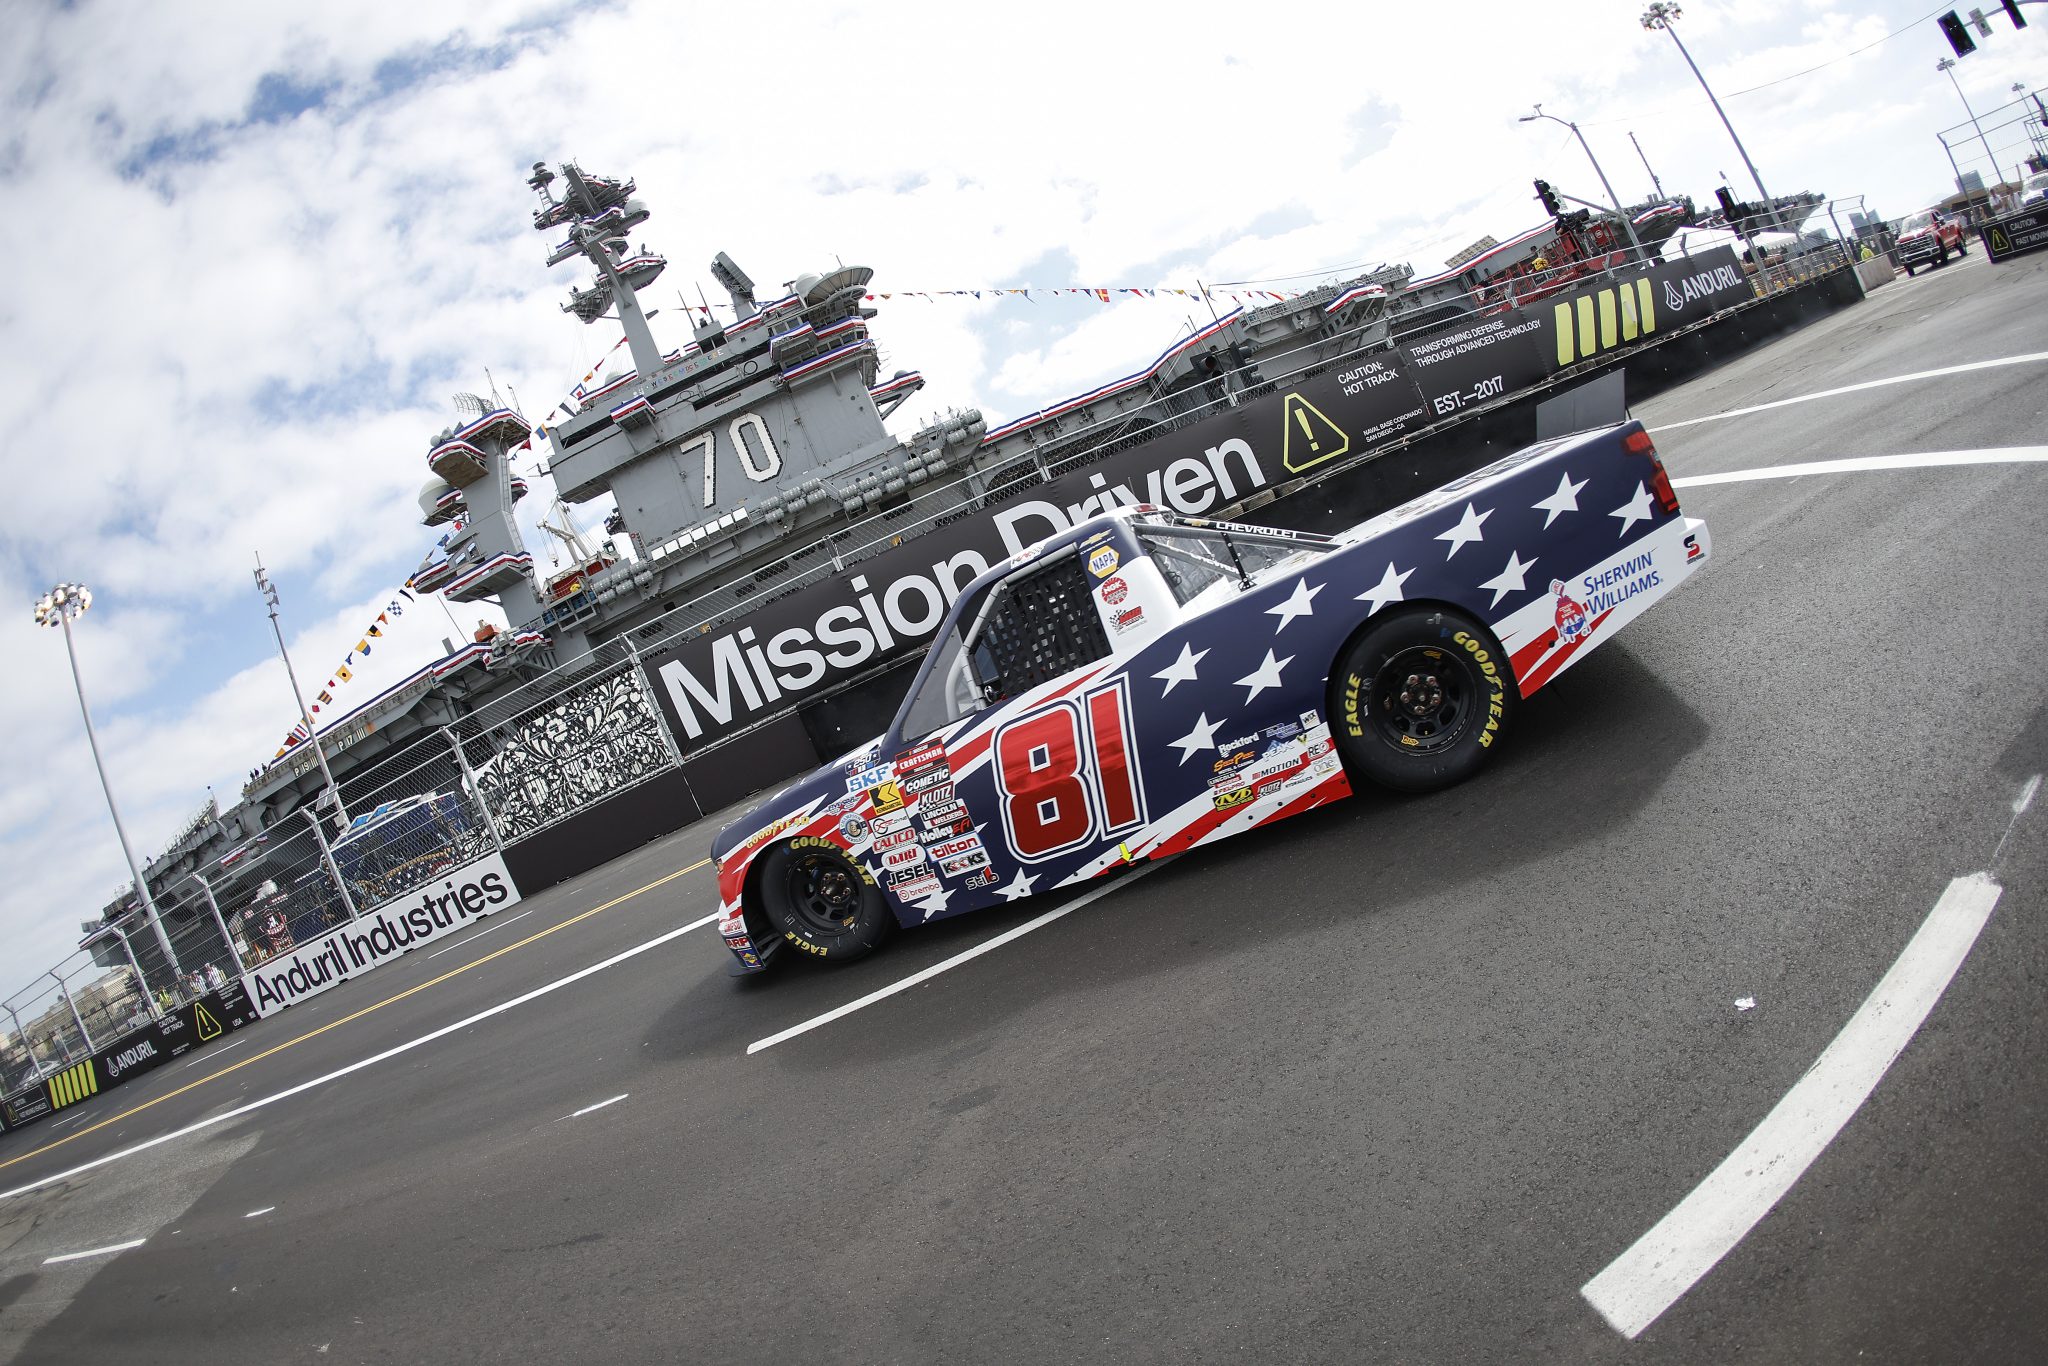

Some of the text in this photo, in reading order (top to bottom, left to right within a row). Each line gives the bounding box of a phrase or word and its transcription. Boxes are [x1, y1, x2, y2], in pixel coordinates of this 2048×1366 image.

[1682, 265, 1742, 302] ANDURIL
[1410, 320, 1505, 357] TRANSFORMING DEFENSE
[1415, 319, 1541, 367] THROUGH ADVANCED TECHNOLOGY
[1337, 361, 1384, 384] CAUTION:
[1343, 368, 1399, 397] HOT TRACK
[1363, 408, 1423, 436] NAVAL BASE CORONADO
[1366, 432, 1378, 443] SAN
[680, 412, 783, 509] 70
[1216, 521, 1297, 539] CHEVROLET
[1092, 552, 1116, 572] NAPA
[658, 438, 1266, 740] Mission Driven
[1104, 580, 1122, 594] NGK
[1453, 631, 1504, 748] GOODYEAR
[1344, 672, 1364, 737] EAGLE
[1218, 731, 1260, 754] Rockford
[1262, 741, 1295, 762] PEAK
[854, 753, 872, 768] 250
[900, 747, 943, 770] CRAFTSMAN
[993, 674, 1148, 862] 81
[1261, 758, 1299, 777] MOTION
[849, 766, 889, 793] SKF
[906, 768, 949, 792] COMETIC
[921, 785, 952, 806] KLOTZ
[922, 803, 957, 820] LINCOLN
[933, 810, 964, 825] WELDERS
[746, 816, 810, 849] GOODYEAR
[873, 829, 915, 852] CALICO
[919, 825, 955, 844] Holley
[932, 837, 978, 858] tilton
[790, 836, 875, 886] GOODYEAR
[887, 863, 934, 886] JESEL
[909, 882, 940, 896] brembo
[253, 872, 508, 1011] Anduril Industries
[726, 937, 749, 948] ARP
[785, 931, 828, 956] EAGLE
[233, 1018, 244, 1027] USA
[117, 1040, 157, 1071] ANDURIL
